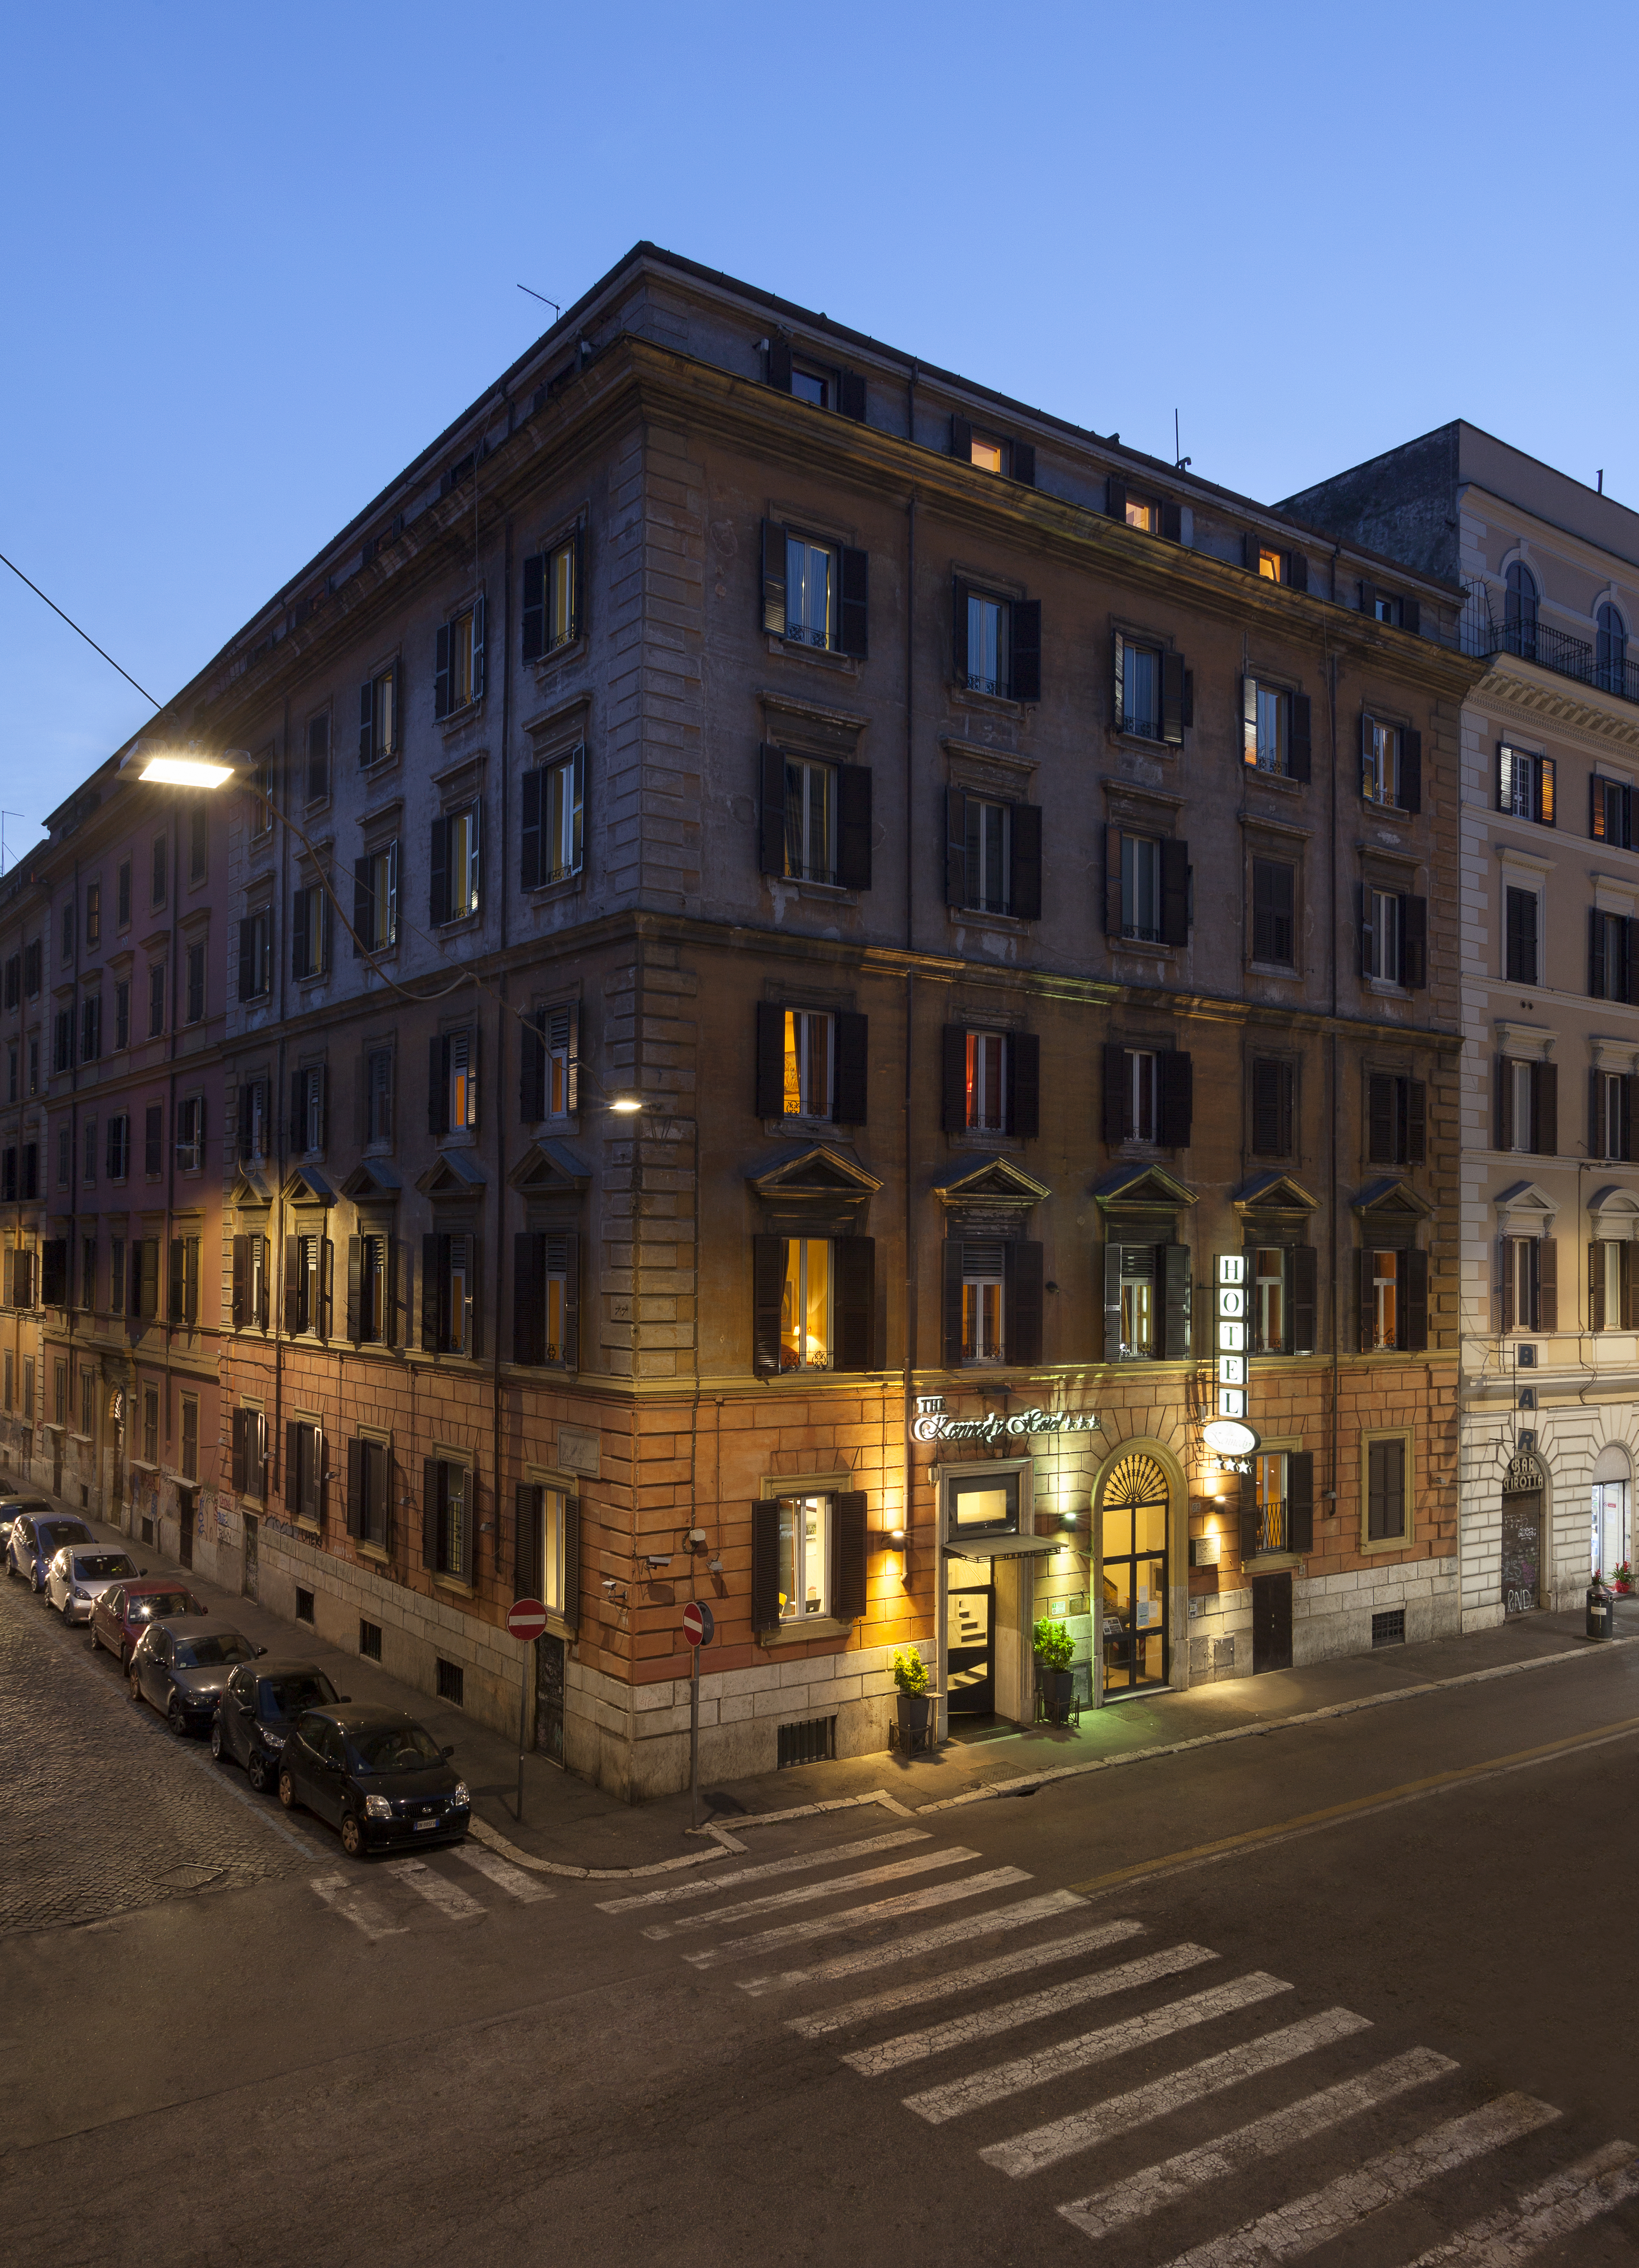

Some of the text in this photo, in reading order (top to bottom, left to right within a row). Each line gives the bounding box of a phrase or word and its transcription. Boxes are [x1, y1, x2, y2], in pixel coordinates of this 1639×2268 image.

[1224, 1260, 1239, 1414] HOTEL
[918, 1396, 946, 1413] THE
[1517, 1345, 1534, 1451] BAR
[912, 1408, 1066, 1443] Kennedy Hotel
[1511, 1457, 1534, 1475] BAR
[1503, 1474, 1543, 1491] TIROTTA
[1192, 1503, 1200, 1511] 62
